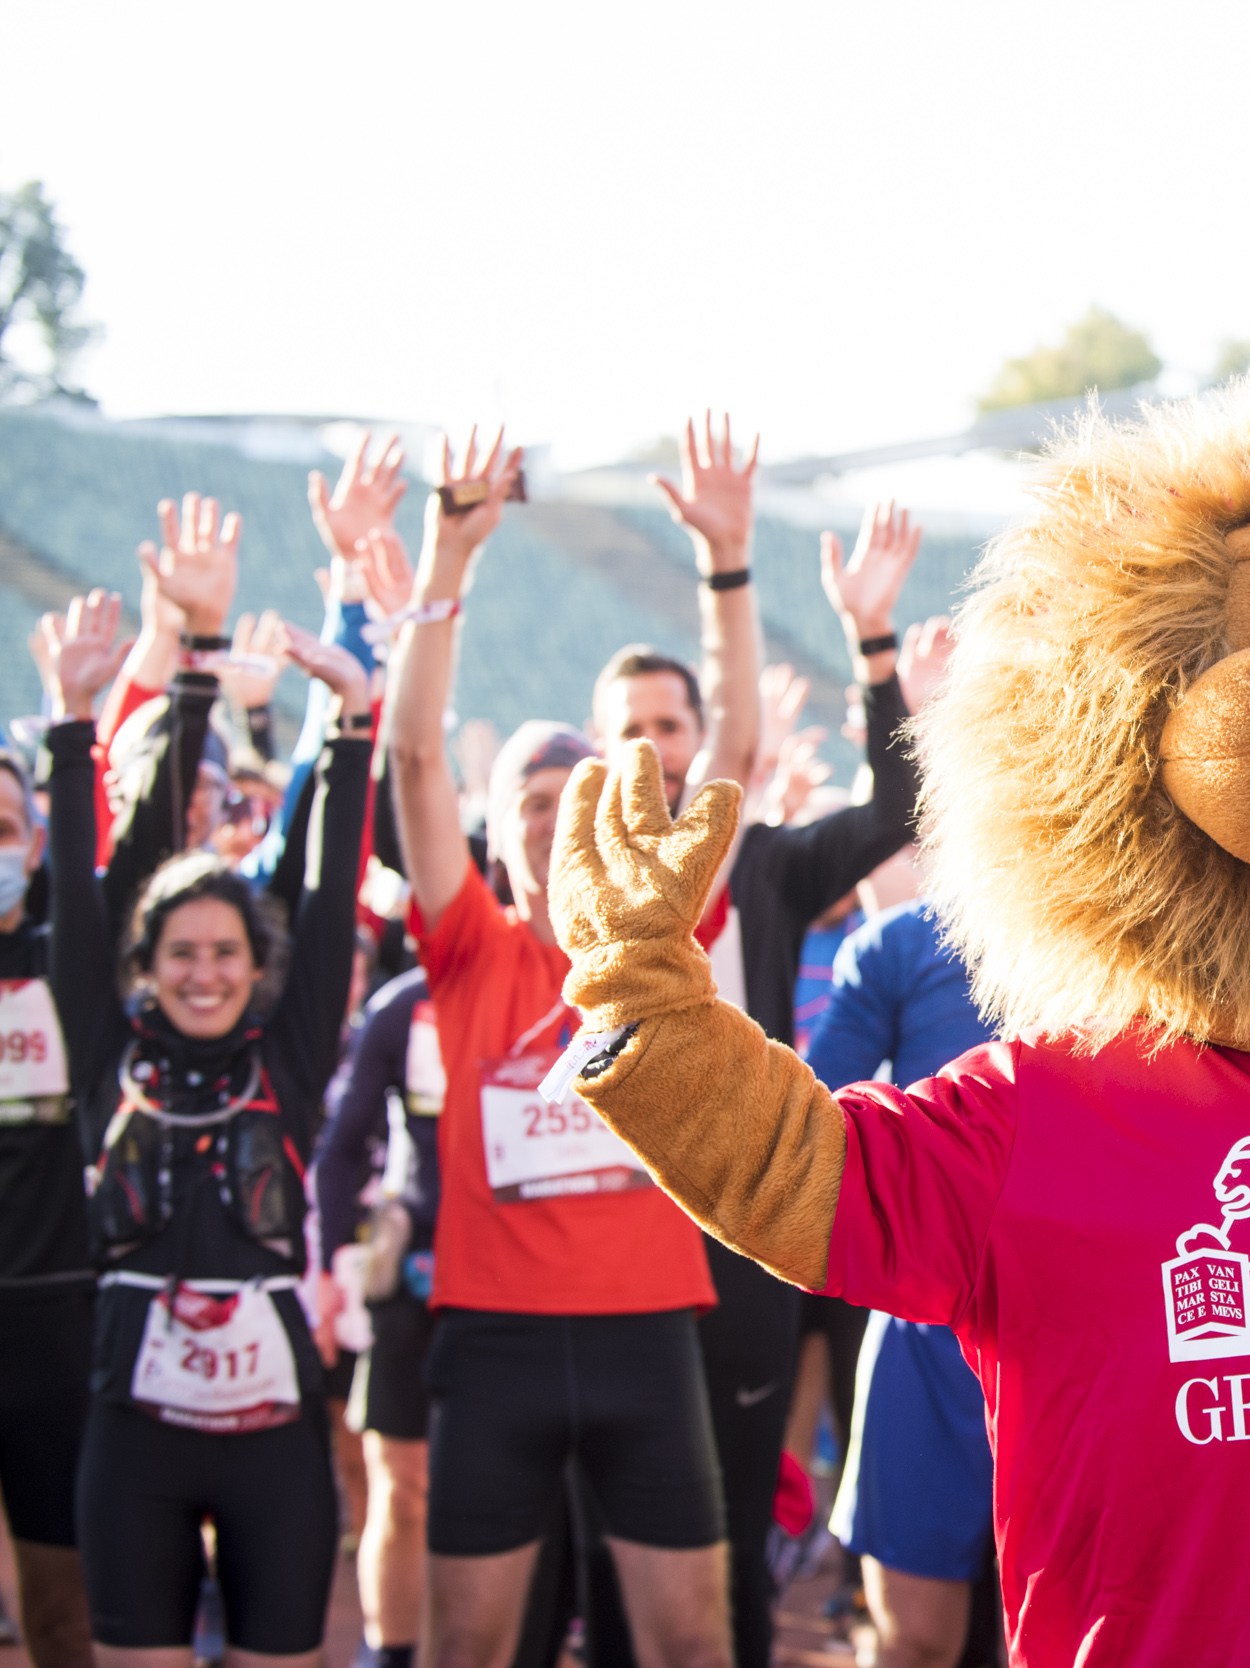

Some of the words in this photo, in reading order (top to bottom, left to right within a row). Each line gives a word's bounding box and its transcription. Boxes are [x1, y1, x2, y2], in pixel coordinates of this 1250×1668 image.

[0, 1029, 47, 1064] 99
[1174, 1266, 1200, 1285] PAX
[1206, 1264, 1235, 1279] VAN
[1175, 1279, 1203, 1298] TIBI
[1208, 1278, 1240, 1293] GELI
[1177, 1292, 1206, 1312] MAR
[1210, 1291, 1236, 1305] STA
[1177, 1310, 1196, 1325] CE
[1197, 1305, 1207, 1318] E
[1211, 1304, 1243, 1320] MEVS
[180, 1337, 260, 1380] 2917
